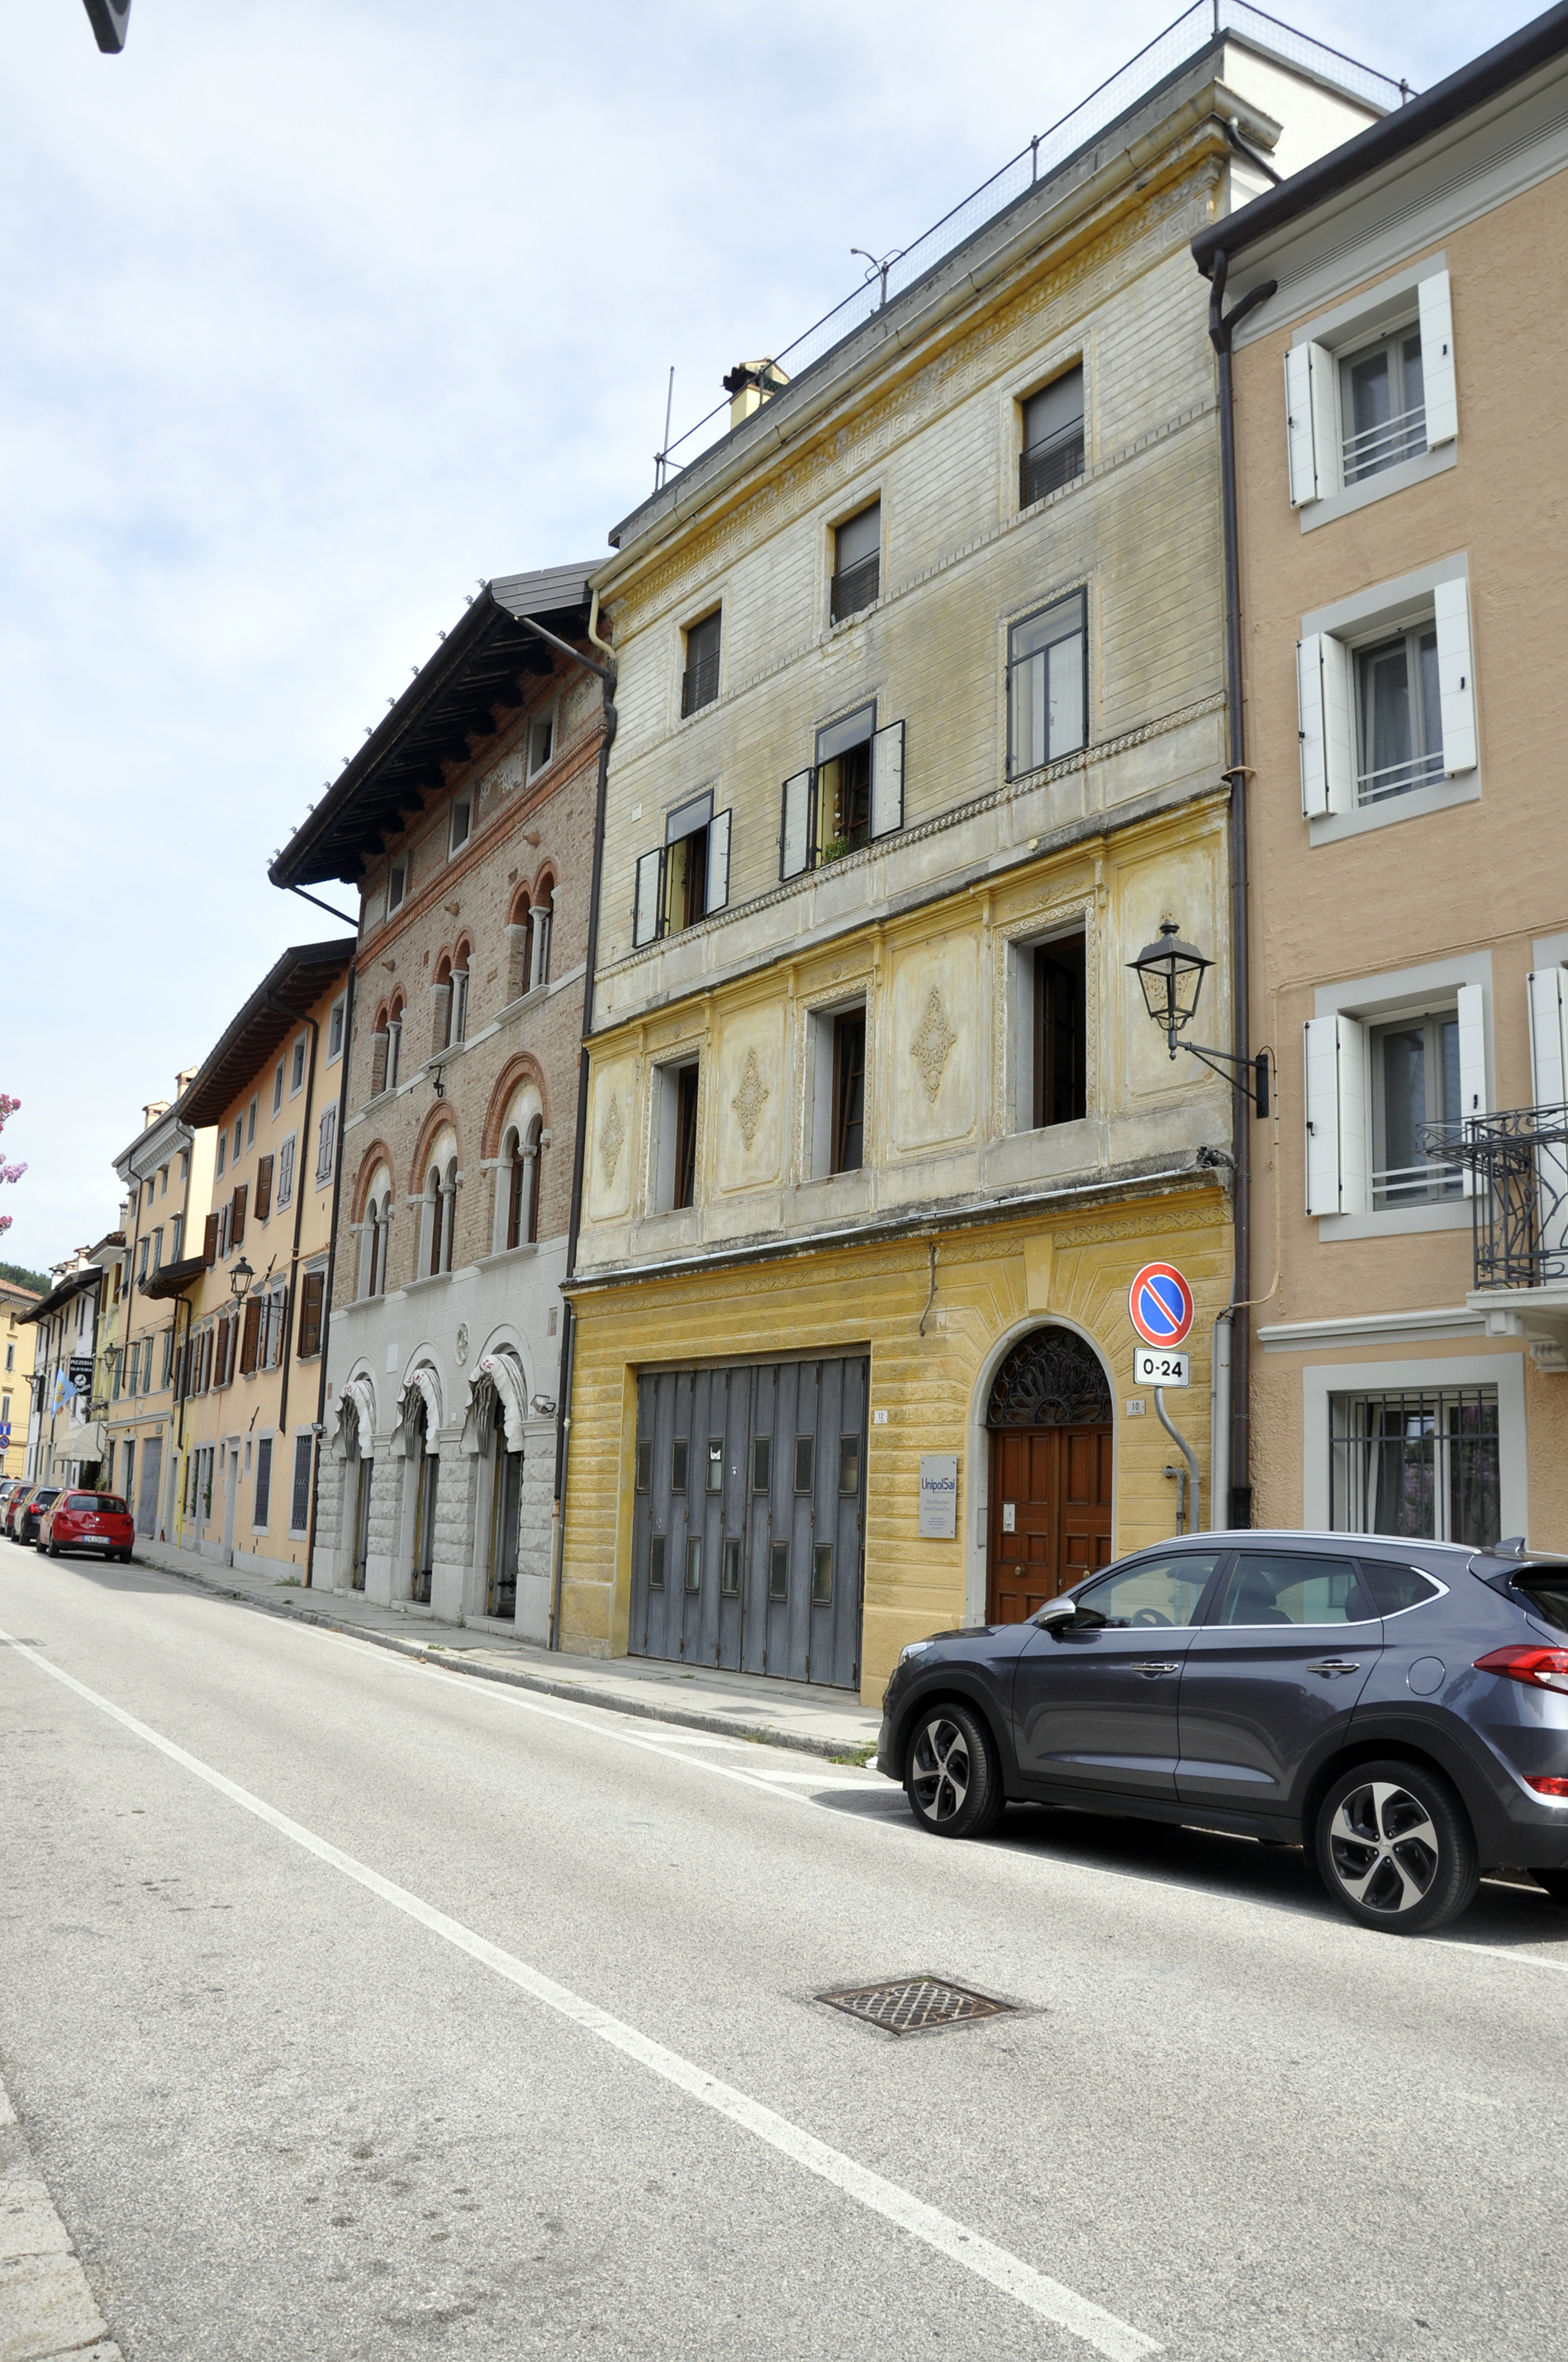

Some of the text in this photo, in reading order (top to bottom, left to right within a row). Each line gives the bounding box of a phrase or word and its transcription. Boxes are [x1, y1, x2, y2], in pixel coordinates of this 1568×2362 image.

[1143, 1358, 1182, 1377] 0-24
[1132, 1402, 1139, 1411] 10
[921, 1477, 955, 1494] UnipolSai
